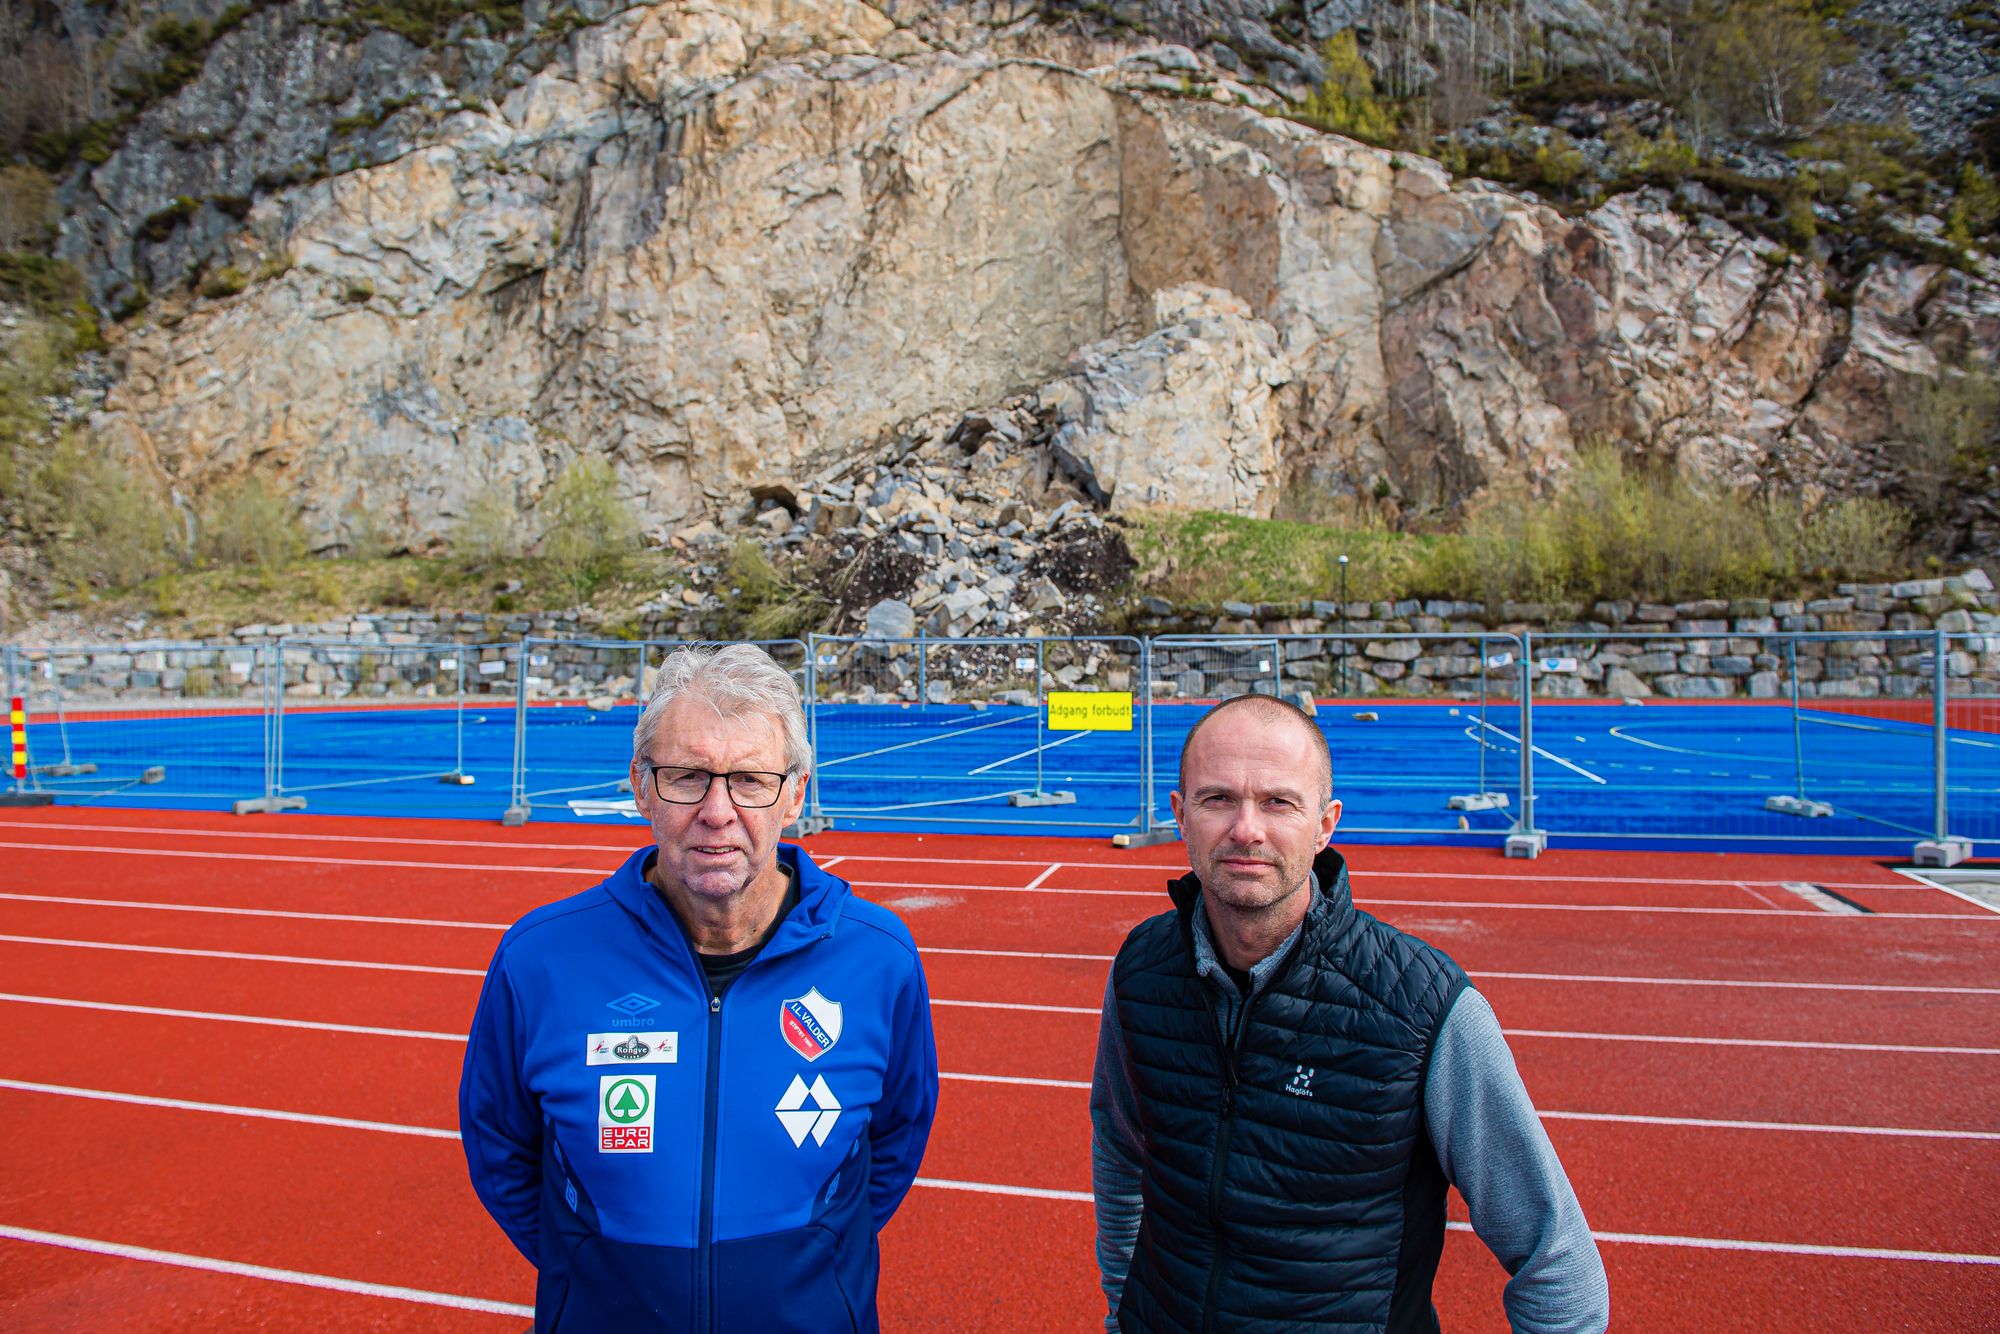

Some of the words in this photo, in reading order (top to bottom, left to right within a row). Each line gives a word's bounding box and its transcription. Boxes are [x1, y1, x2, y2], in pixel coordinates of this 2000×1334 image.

[1050, 704, 1088, 719] Adgang
[1092, 704, 1131, 717] forbudt
[611, 1016, 655, 1028] umbro
[617, 1045, 648, 1055] Rongve
[1285, 1083, 1313, 1097] Haglöfs
[603, 1128, 649, 1138] EURO
[603, 1138, 649, 1148] SPAR
